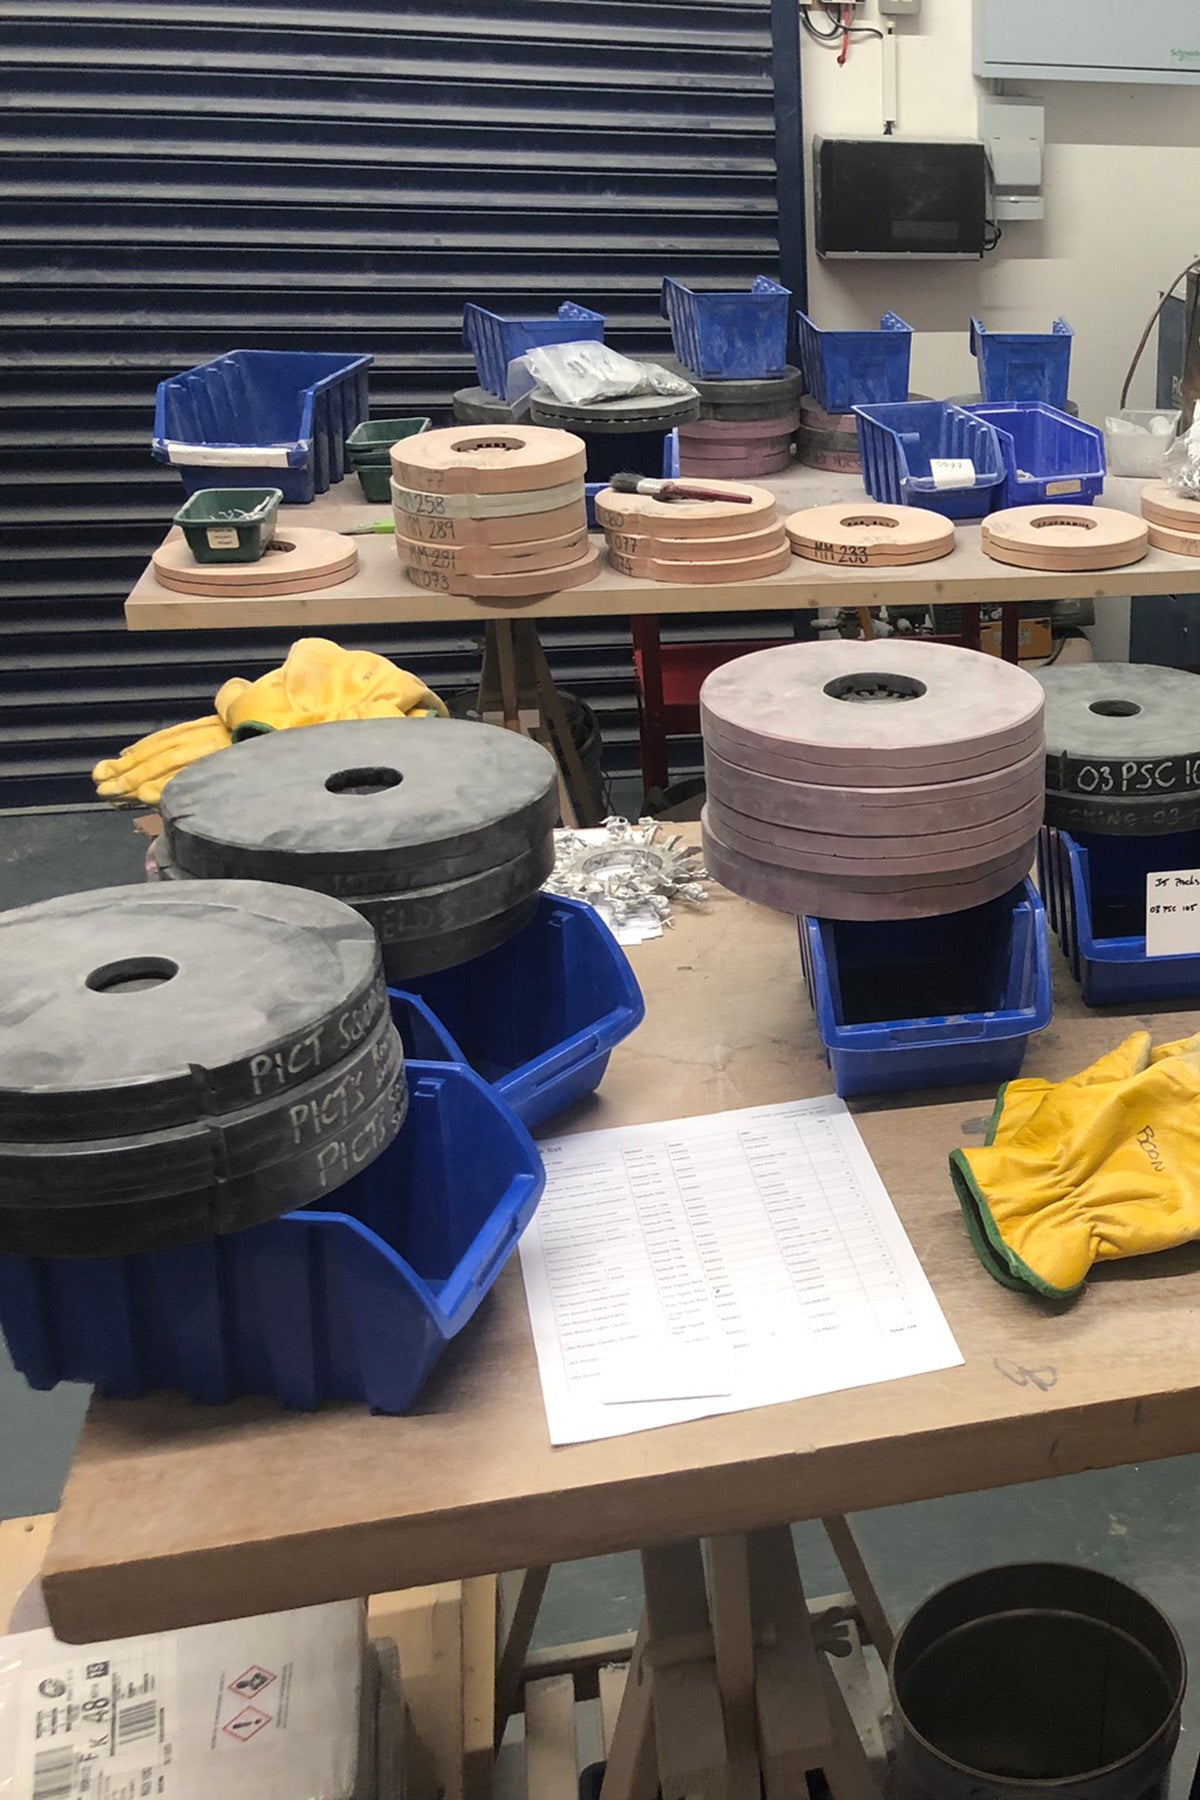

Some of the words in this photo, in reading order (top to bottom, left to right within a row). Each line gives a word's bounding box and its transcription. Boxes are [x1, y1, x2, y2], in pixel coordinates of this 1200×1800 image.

[417, 495, 445, 514] 258
[429, 521, 456, 540] 289
[815, 541, 835, 562] MM
[838, 546, 869, 565] 233
[250, 1026, 325, 1096] PICT
